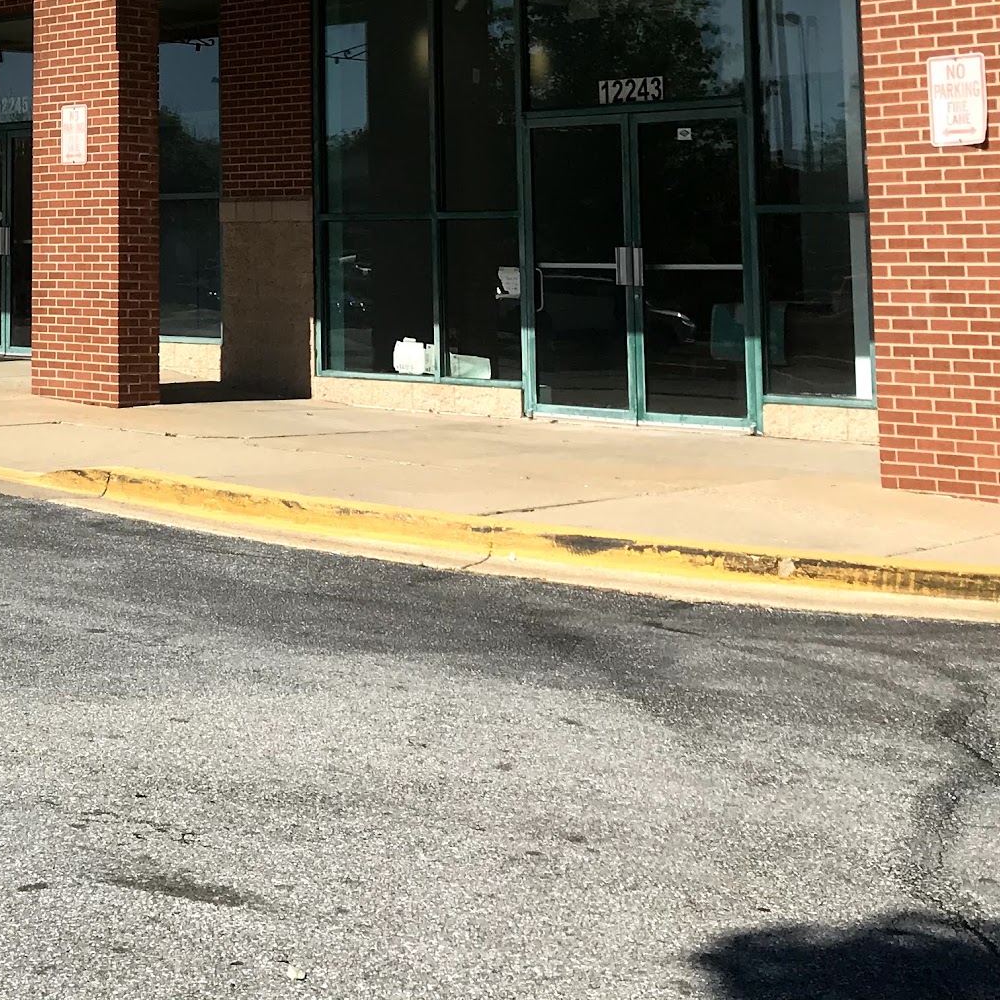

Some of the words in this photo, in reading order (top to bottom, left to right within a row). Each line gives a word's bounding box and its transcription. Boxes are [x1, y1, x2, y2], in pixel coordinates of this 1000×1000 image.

[946, 63, 965, 80] NO
[601, 77, 662, 103] 12243
[934, 80, 980, 100] PARKING
